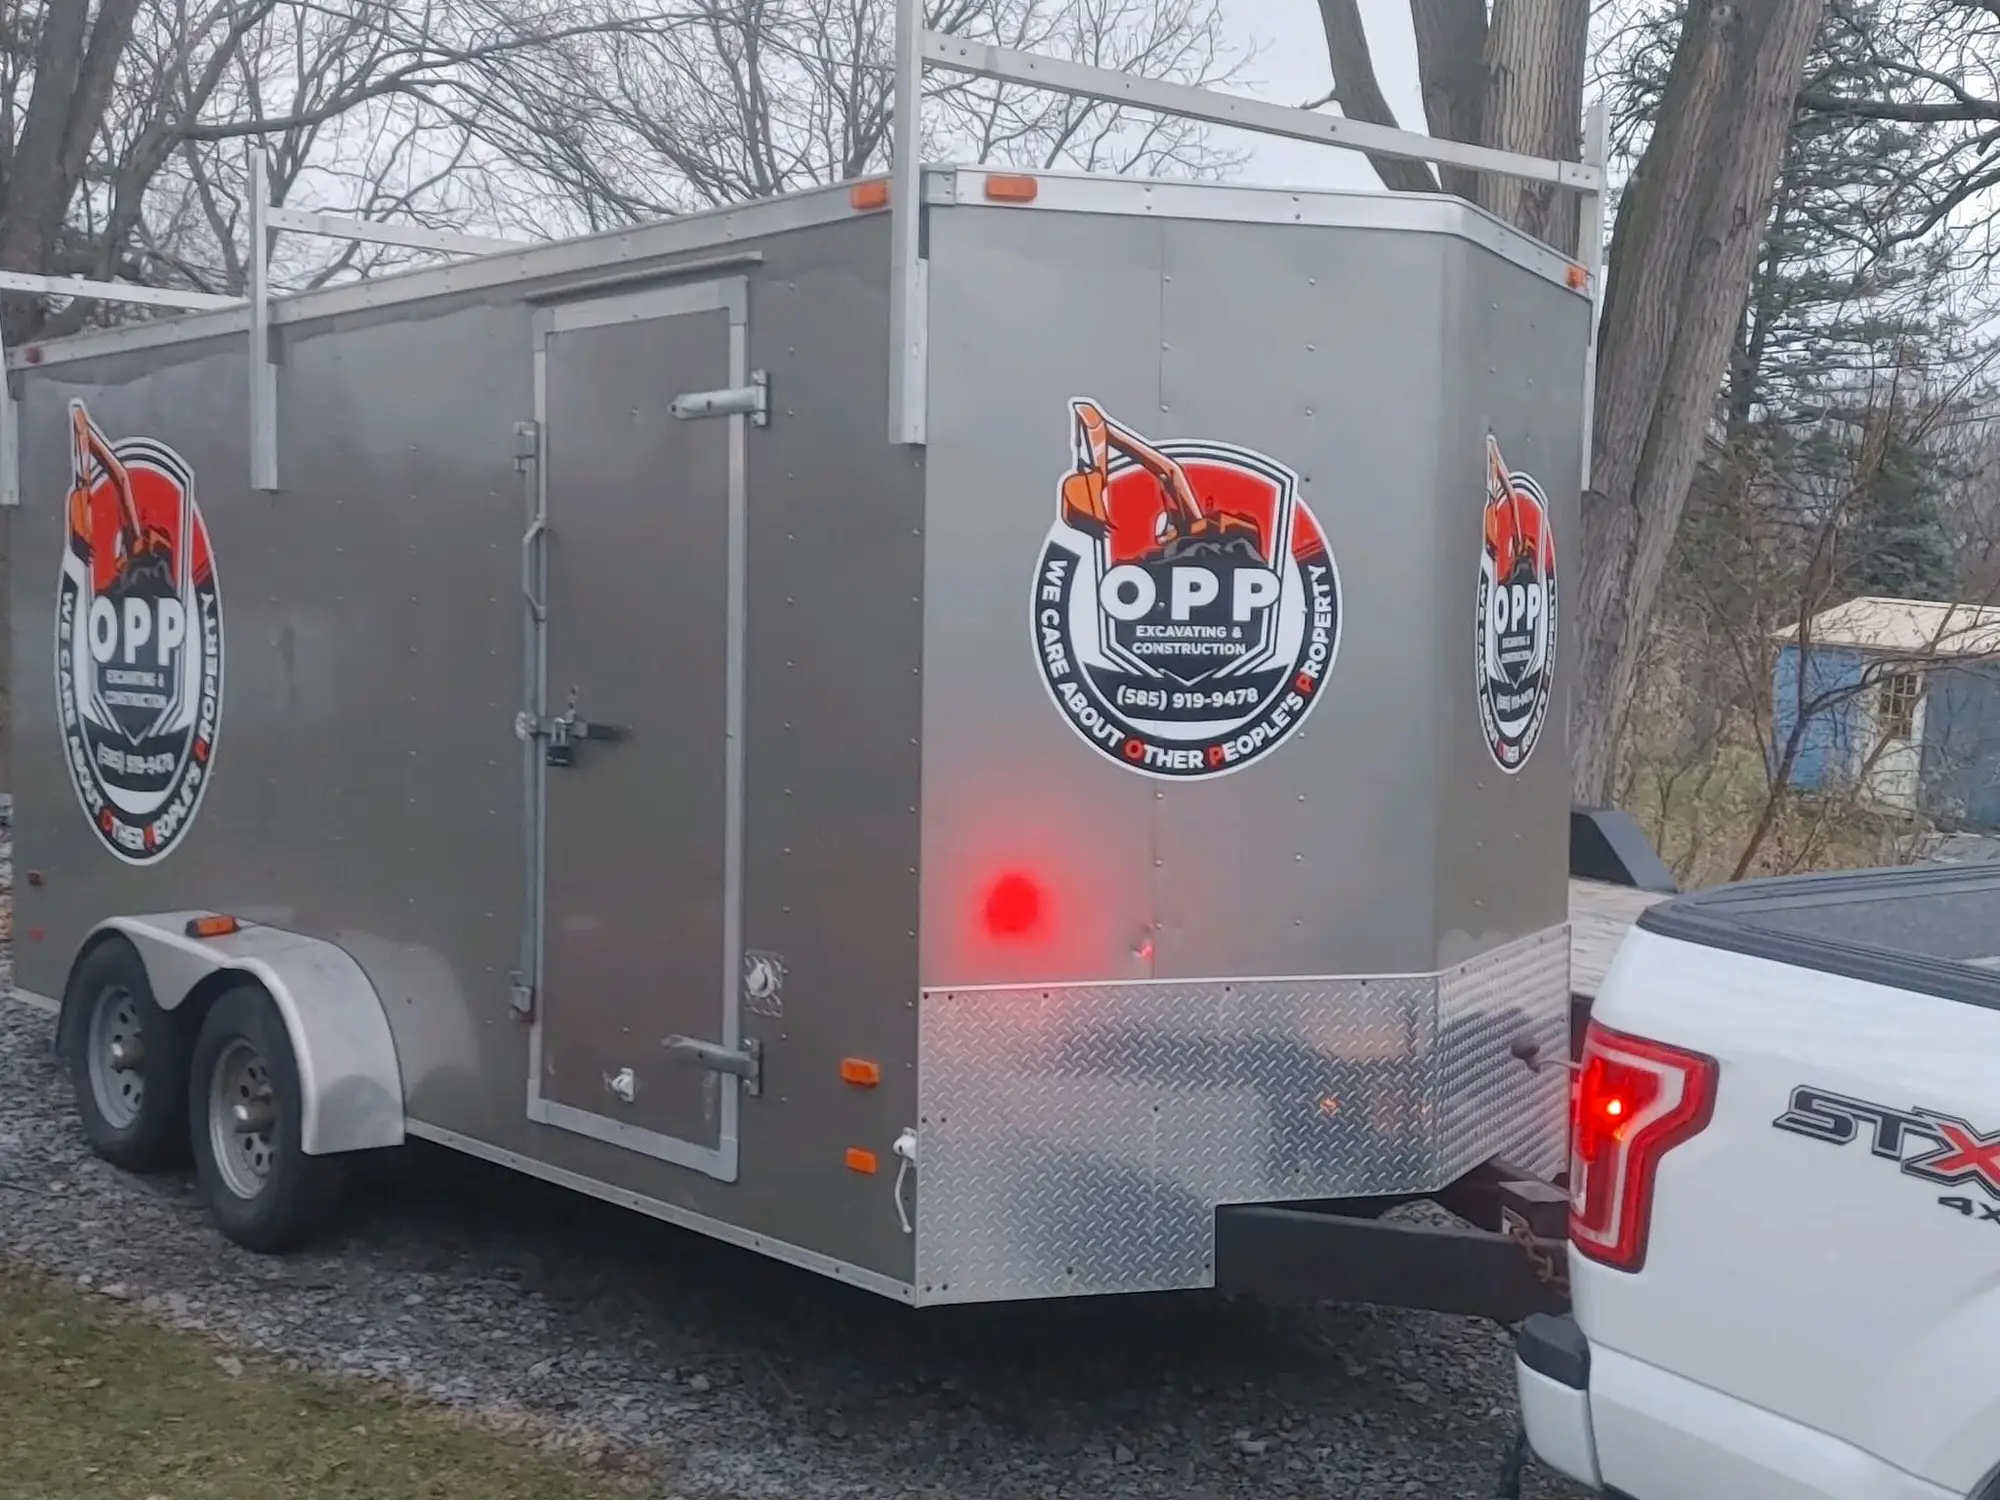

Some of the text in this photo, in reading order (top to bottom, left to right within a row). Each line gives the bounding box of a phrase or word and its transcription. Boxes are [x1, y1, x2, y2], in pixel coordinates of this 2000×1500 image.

[1099, 564, 1282, 622] OPP
[1494, 583, 1541, 634] OPP
[89, 595, 185, 666] OPP
[1132, 642, 1246, 655] CONSTRUCTION
[1135, 625, 1242, 638] EXCAVATING &
[1040, 560, 1332, 769] WE CARE ABOUT OTHER PEOPLE'S PROPERTY
[1116, 685, 1259, 711] (585) 919-9478
[1772, 1084, 2000, 1200] STX
